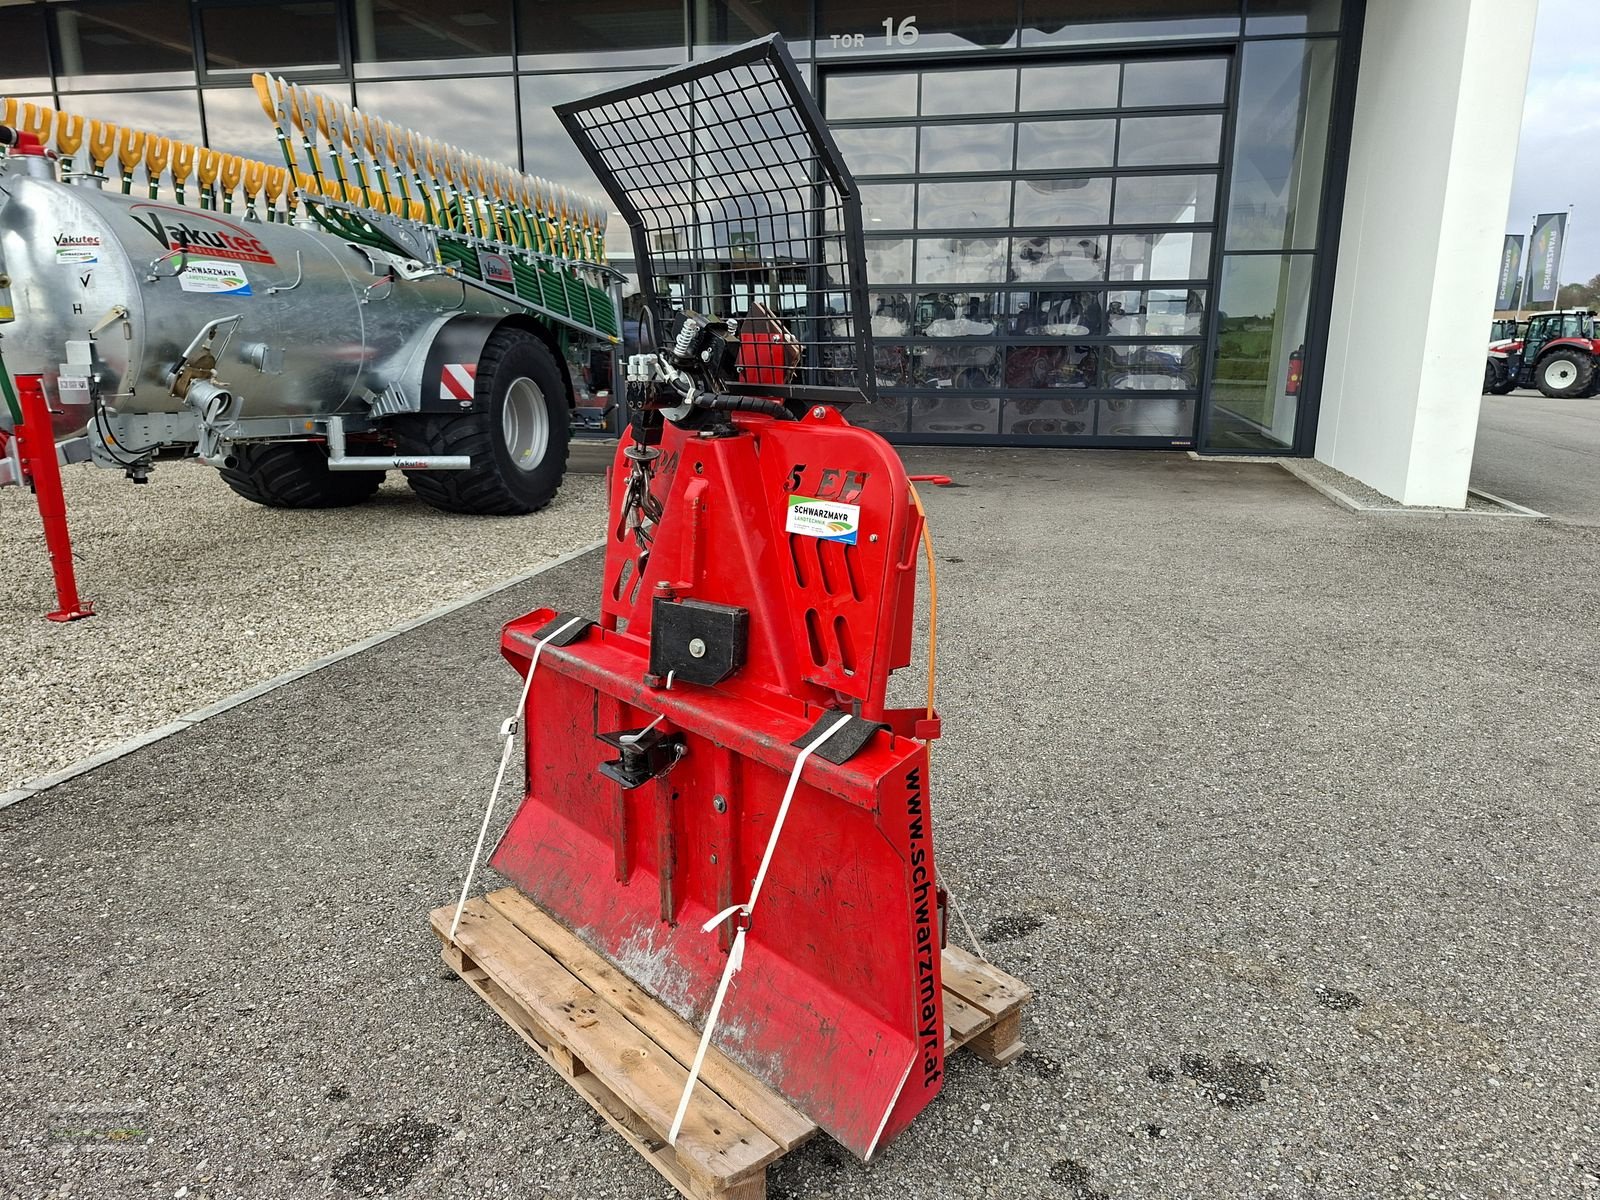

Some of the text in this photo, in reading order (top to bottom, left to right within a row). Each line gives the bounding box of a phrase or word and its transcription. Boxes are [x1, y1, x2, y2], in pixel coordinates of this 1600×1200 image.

[830, 16, 919, 48] TOR 16
[53, 233, 100, 246] Vakutec
[129, 212, 269, 254] Vakutec
[73, 303, 82, 314] H
[783, 464, 806, 492] 5
[794, 505, 849, 521] SCHWARZMAYR
[905, 767, 941, 1087] www.schwarzmayr.at
